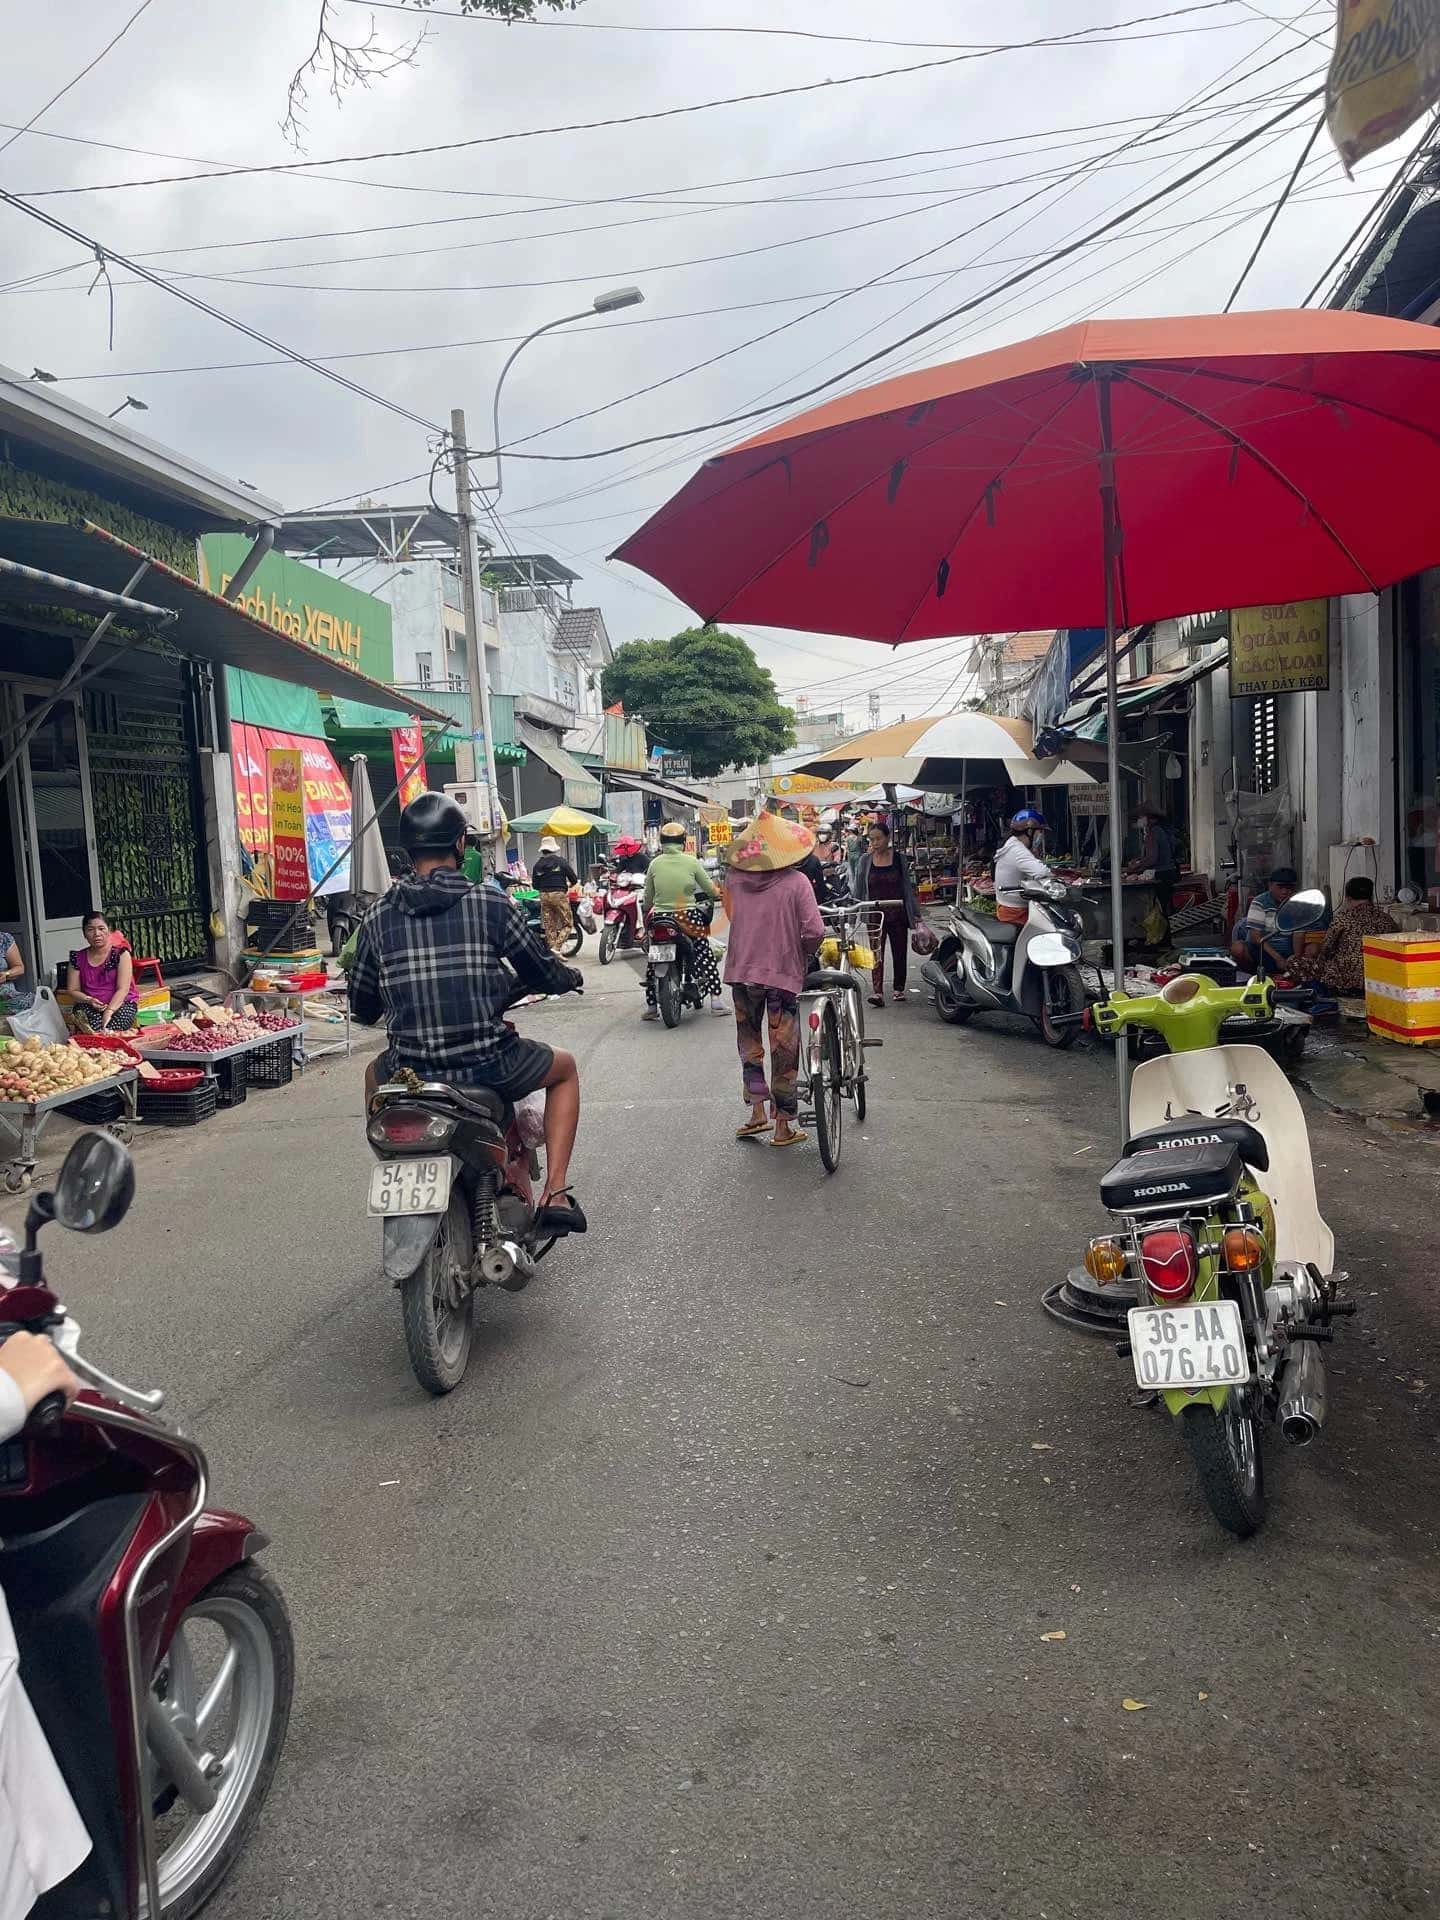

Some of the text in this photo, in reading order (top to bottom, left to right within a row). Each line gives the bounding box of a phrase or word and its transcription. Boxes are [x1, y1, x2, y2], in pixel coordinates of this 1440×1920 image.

[271, 592, 301, 640] hóa
[302, 604, 361, 659] XANH
[1238, 681, 1270, 693] THAY
[275, 845, 305, 863] 100%
[1157, 1134, 1223, 1150] HONDA
[382, 1162, 439, 1187] 54-N9
[380, 1186, 437, 1212] 9162
[1133, 1182, 1191, 1198] HONDA
[1146, 1307, 1225, 1345] 36-AA
[1142, 1344, 1241, 1383] 076.40
